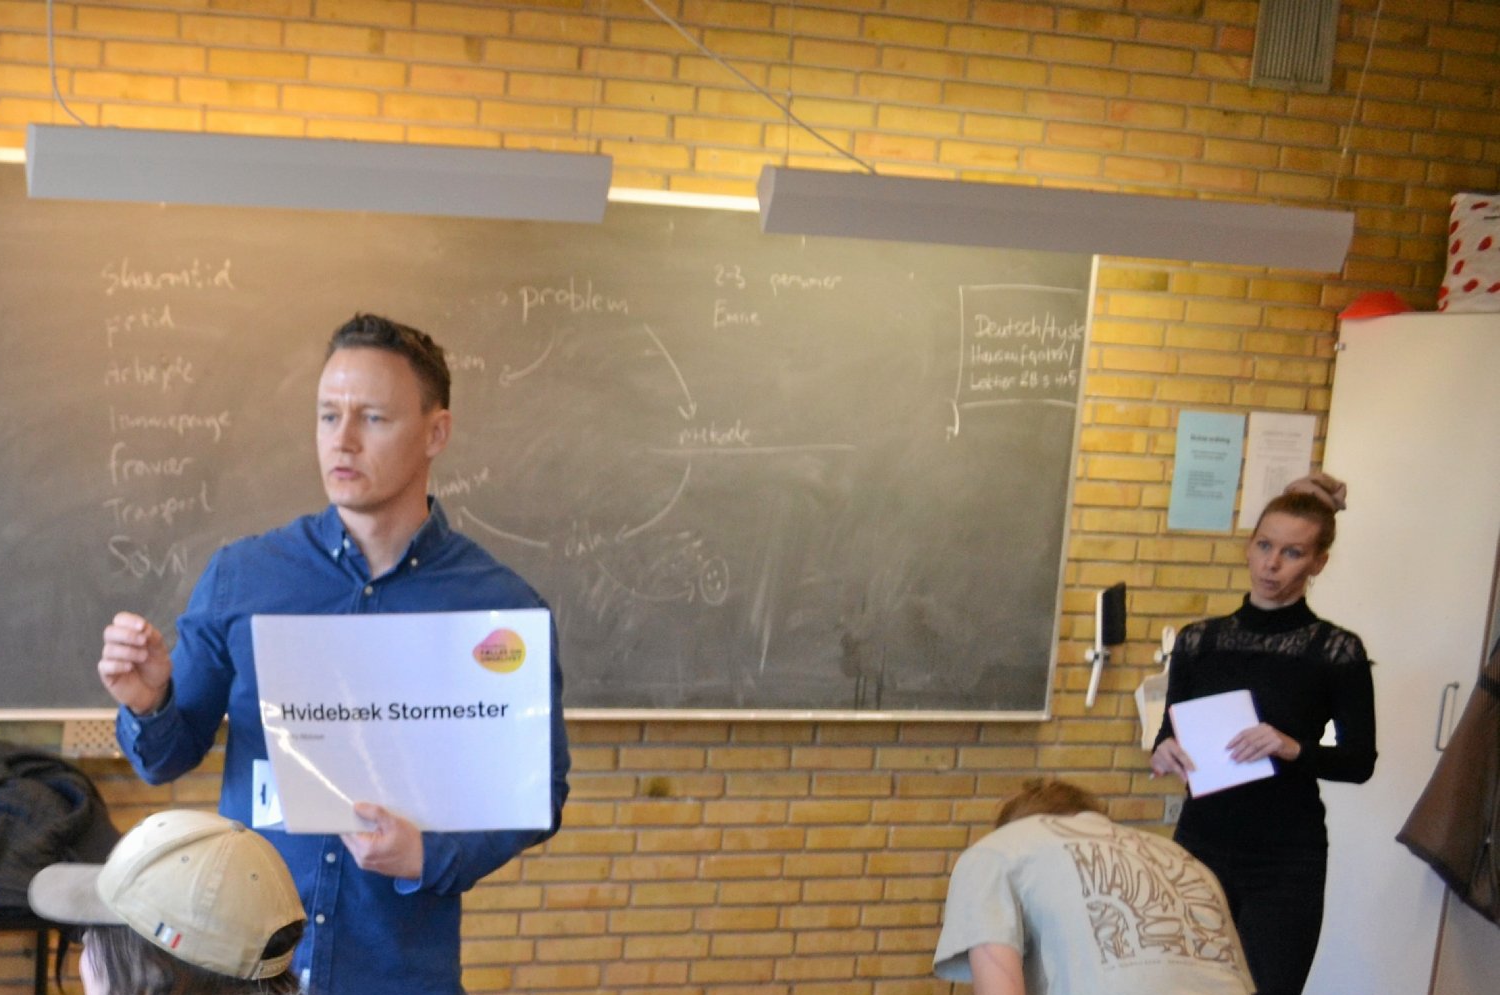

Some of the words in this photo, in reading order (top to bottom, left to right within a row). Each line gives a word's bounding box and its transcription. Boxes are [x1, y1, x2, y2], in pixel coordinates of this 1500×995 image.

[522, 276, 629, 324] problem
[281, 702, 383, 721] Hvidebæk
[389, 701, 509, 721] Stormester
